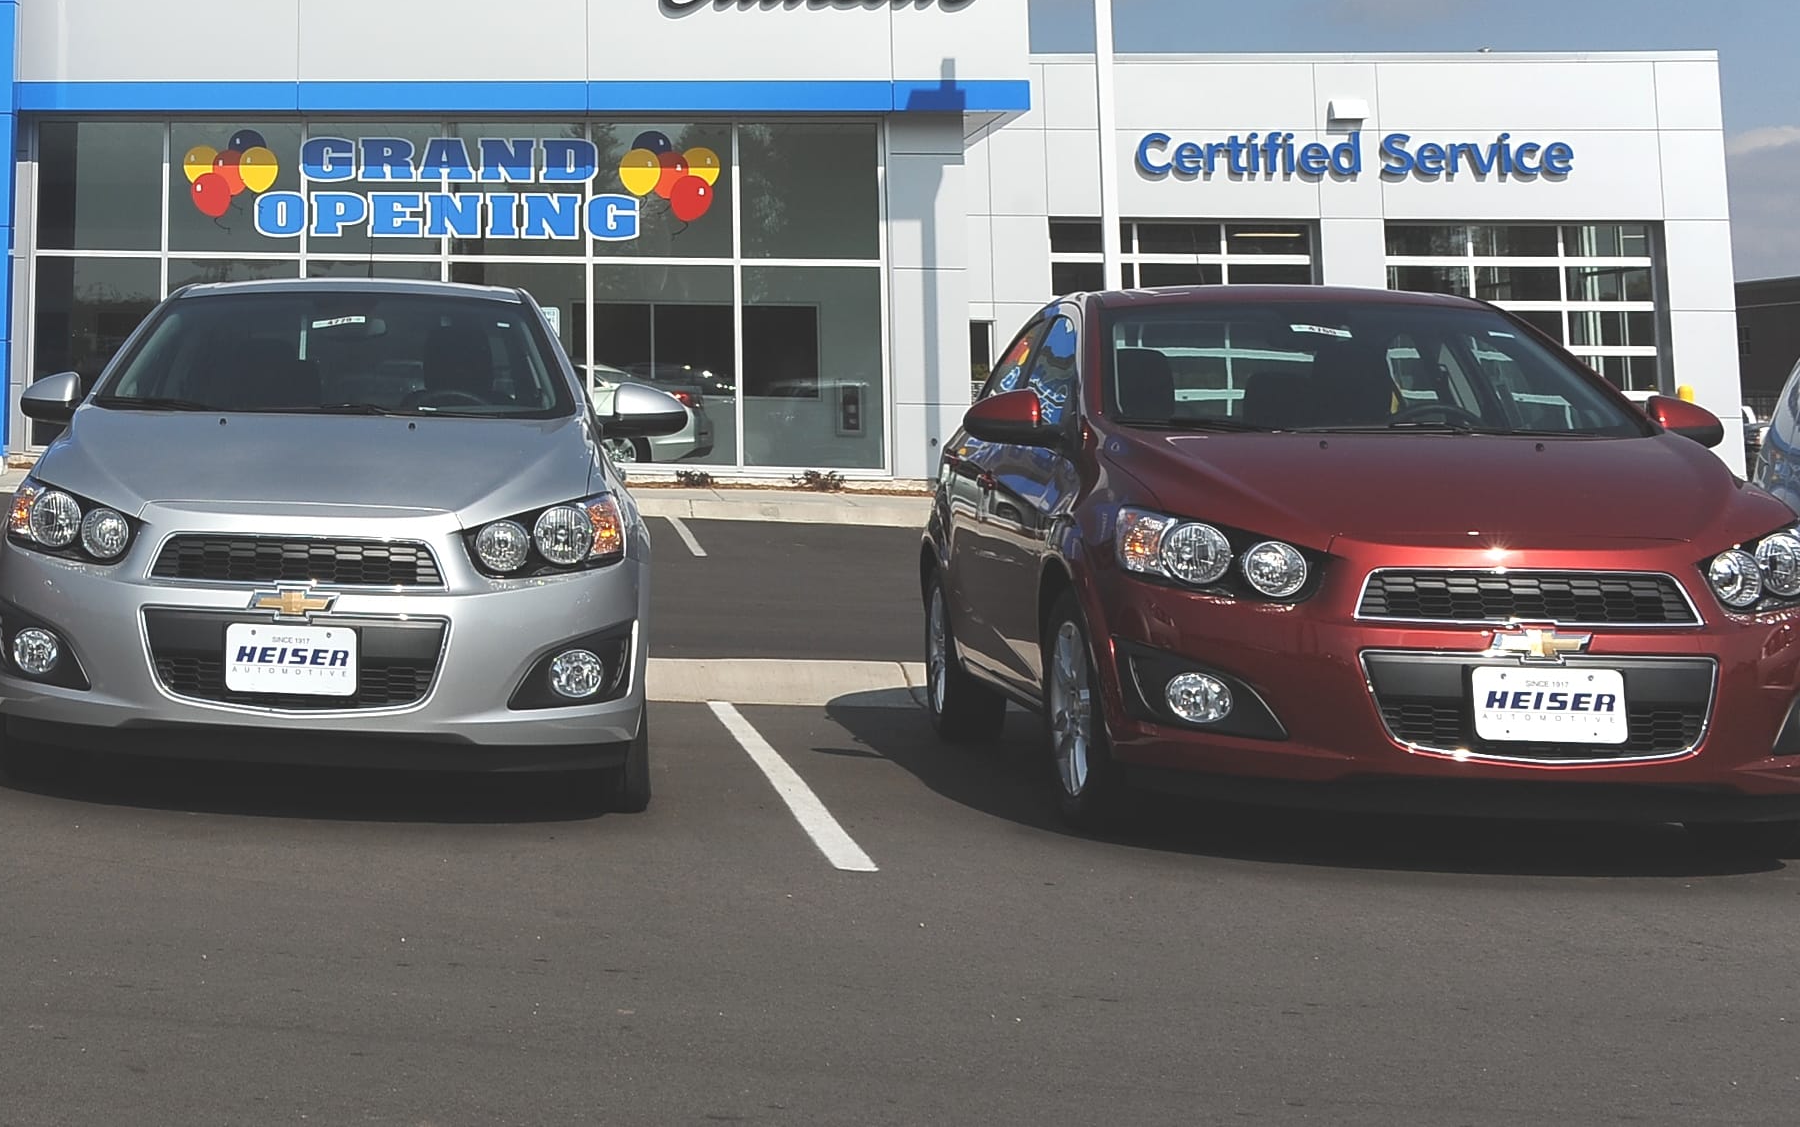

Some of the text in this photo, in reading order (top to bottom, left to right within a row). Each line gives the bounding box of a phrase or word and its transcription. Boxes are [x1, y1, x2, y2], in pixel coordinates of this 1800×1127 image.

[298, 136, 599, 183] GRAND
[1136, 131, 1575, 178] Certified Service
[254, 191, 640, 241] OPENING
[272, 636, 292, 644] SINCE
[235, 646, 350, 667] HEISER
[232, 666, 346, 677] AUTOMOTIVE
[1485, 691, 1616, 712] HEISER
[1482, 713, 1616, 723] AUTOMOTIVE
